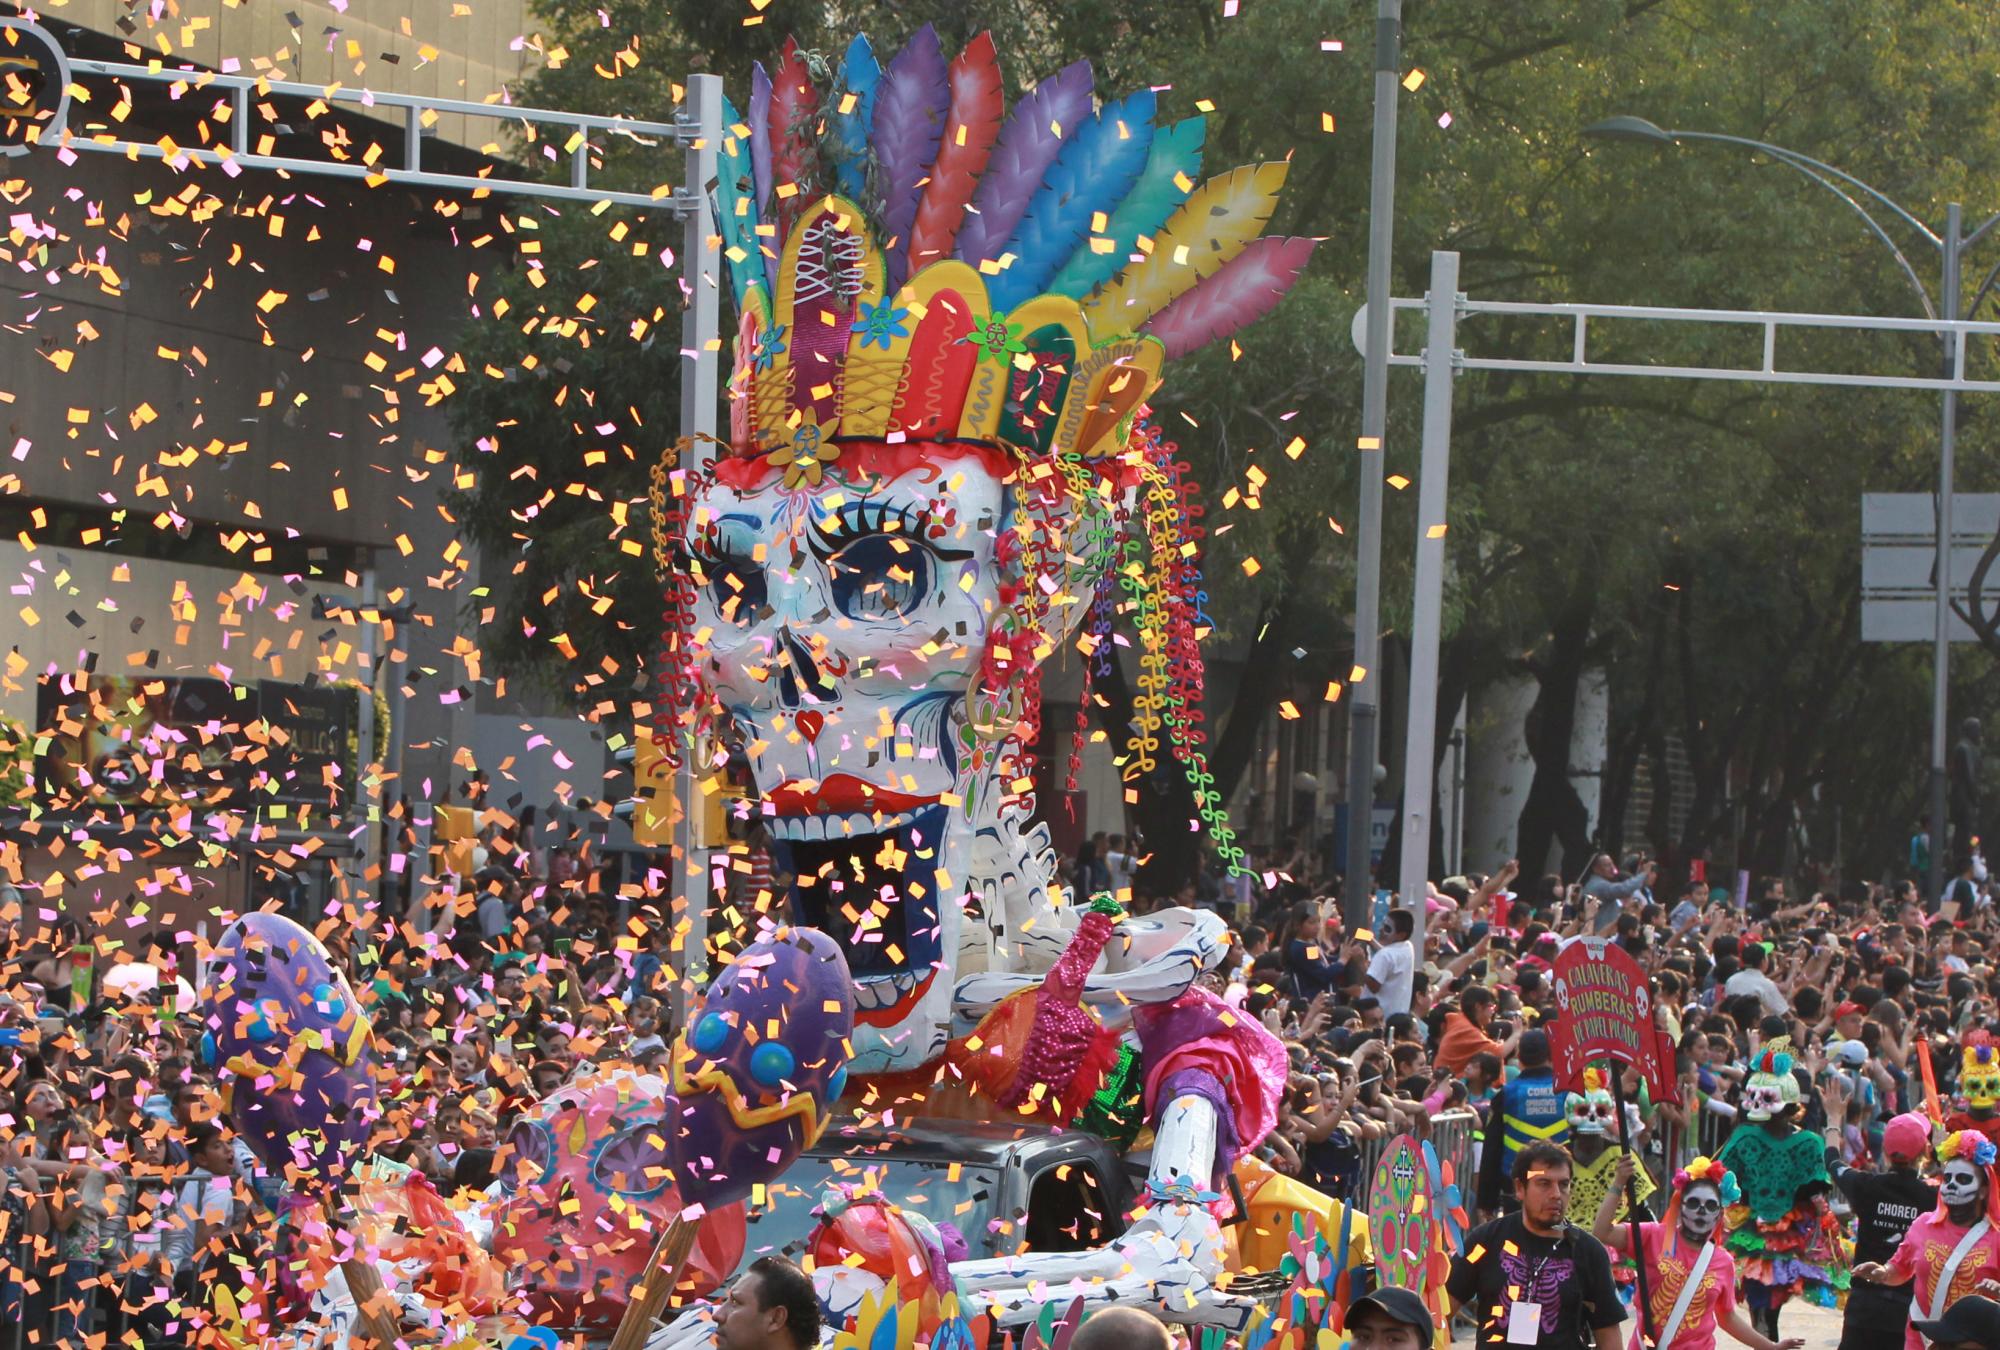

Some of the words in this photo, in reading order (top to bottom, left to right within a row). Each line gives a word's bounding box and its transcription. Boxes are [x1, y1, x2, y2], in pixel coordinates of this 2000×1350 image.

[1568, 963, 1630, 996] CALAVERAS
[1570, 990, 1635, 1022] RUMBERAS
[1573, 1020, 1588, 1047] DE
[1584, 1016, 1609, 1040] PAPEL
[1609, 1018, 1639, 1051] PICADO
[1873, 1219, 1899, 1230] ANIMA
[1877, 1202, 1918, 1220] CHOREO
